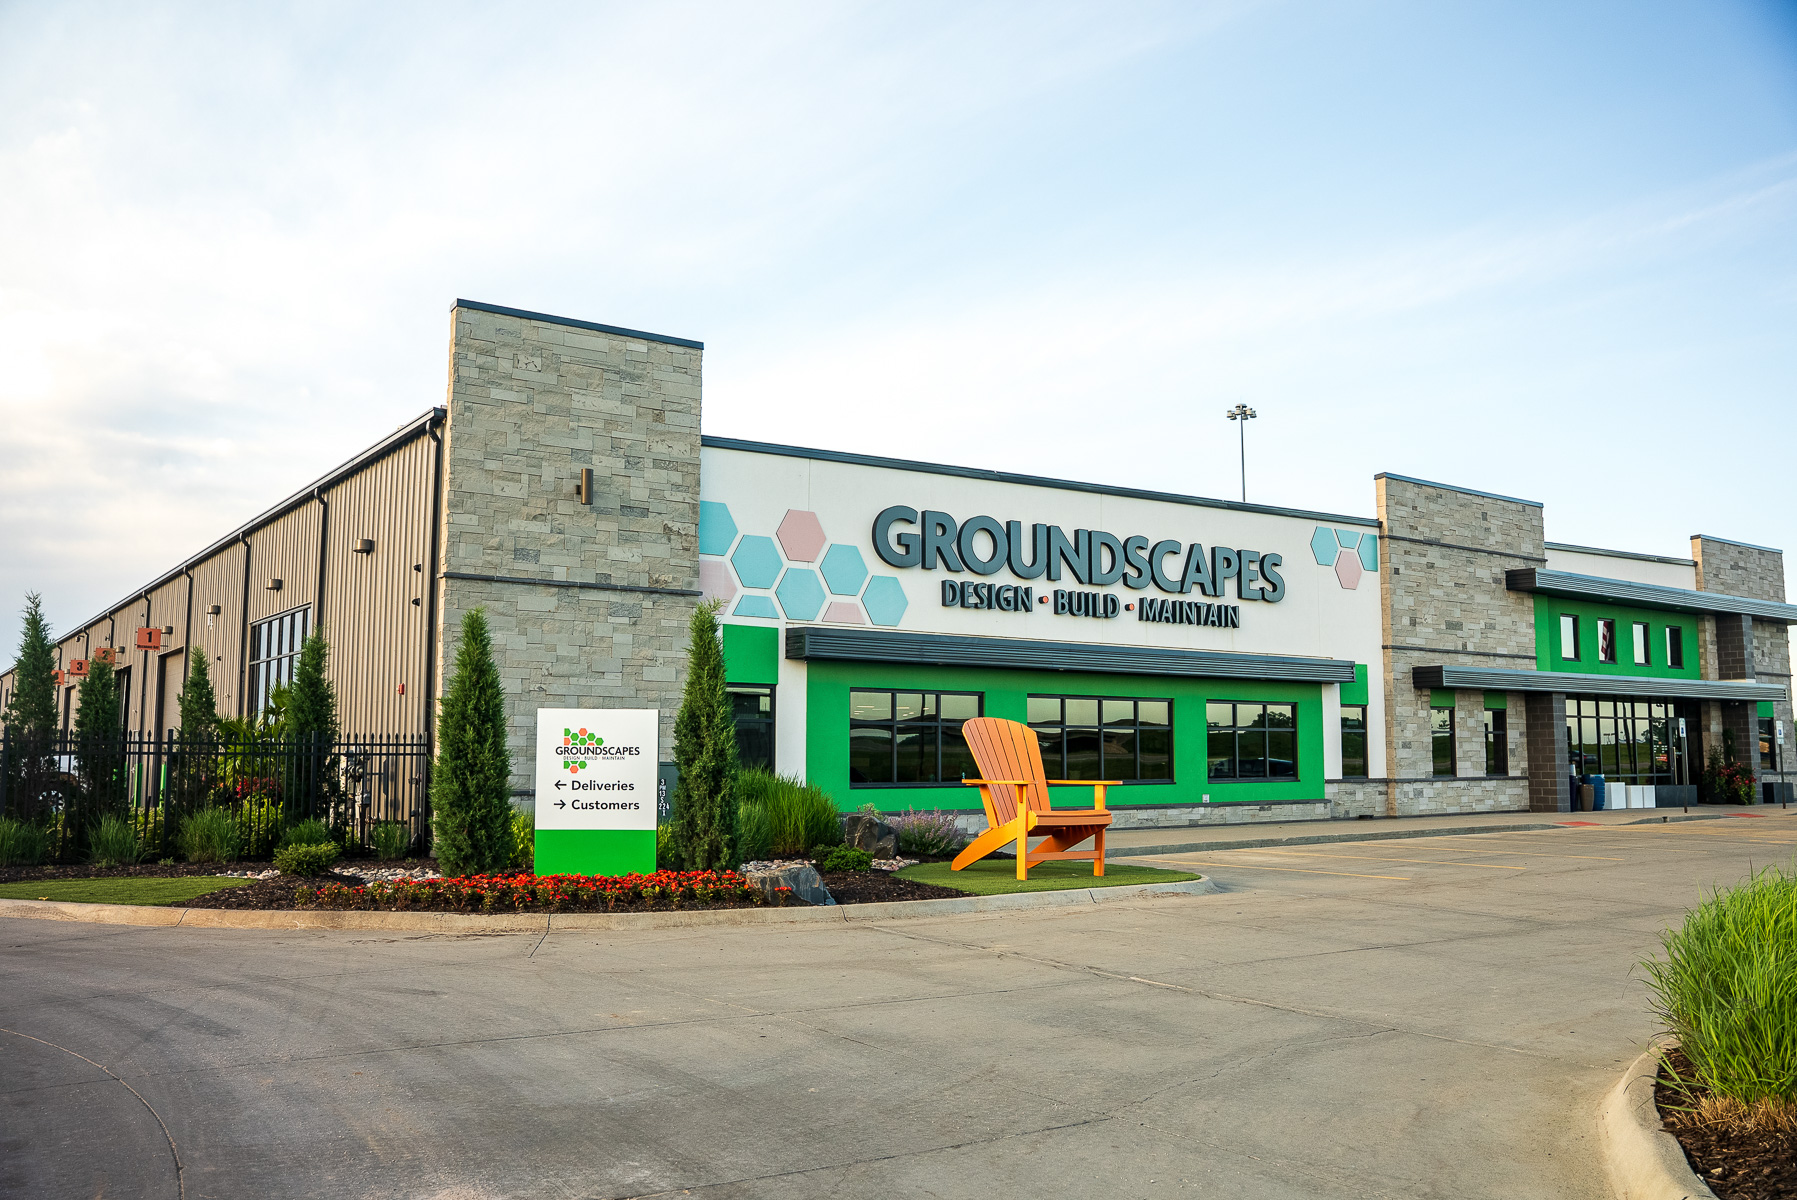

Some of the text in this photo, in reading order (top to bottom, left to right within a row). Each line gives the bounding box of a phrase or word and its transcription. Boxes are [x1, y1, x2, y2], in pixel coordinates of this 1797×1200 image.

[872, 505, 1285, 602] GROUNDSCAPES
[941, 580, 1240, 628] DESIGN BUILD MAINTAIN
[146, 631, 152, 643] 1
[76, 662, 83, 671] 3
[555, 746, 640, 756] GROUNDSCAPES
[571, 780, 635, 791] Deliveries
[571, 799, 640, 810] Customers
